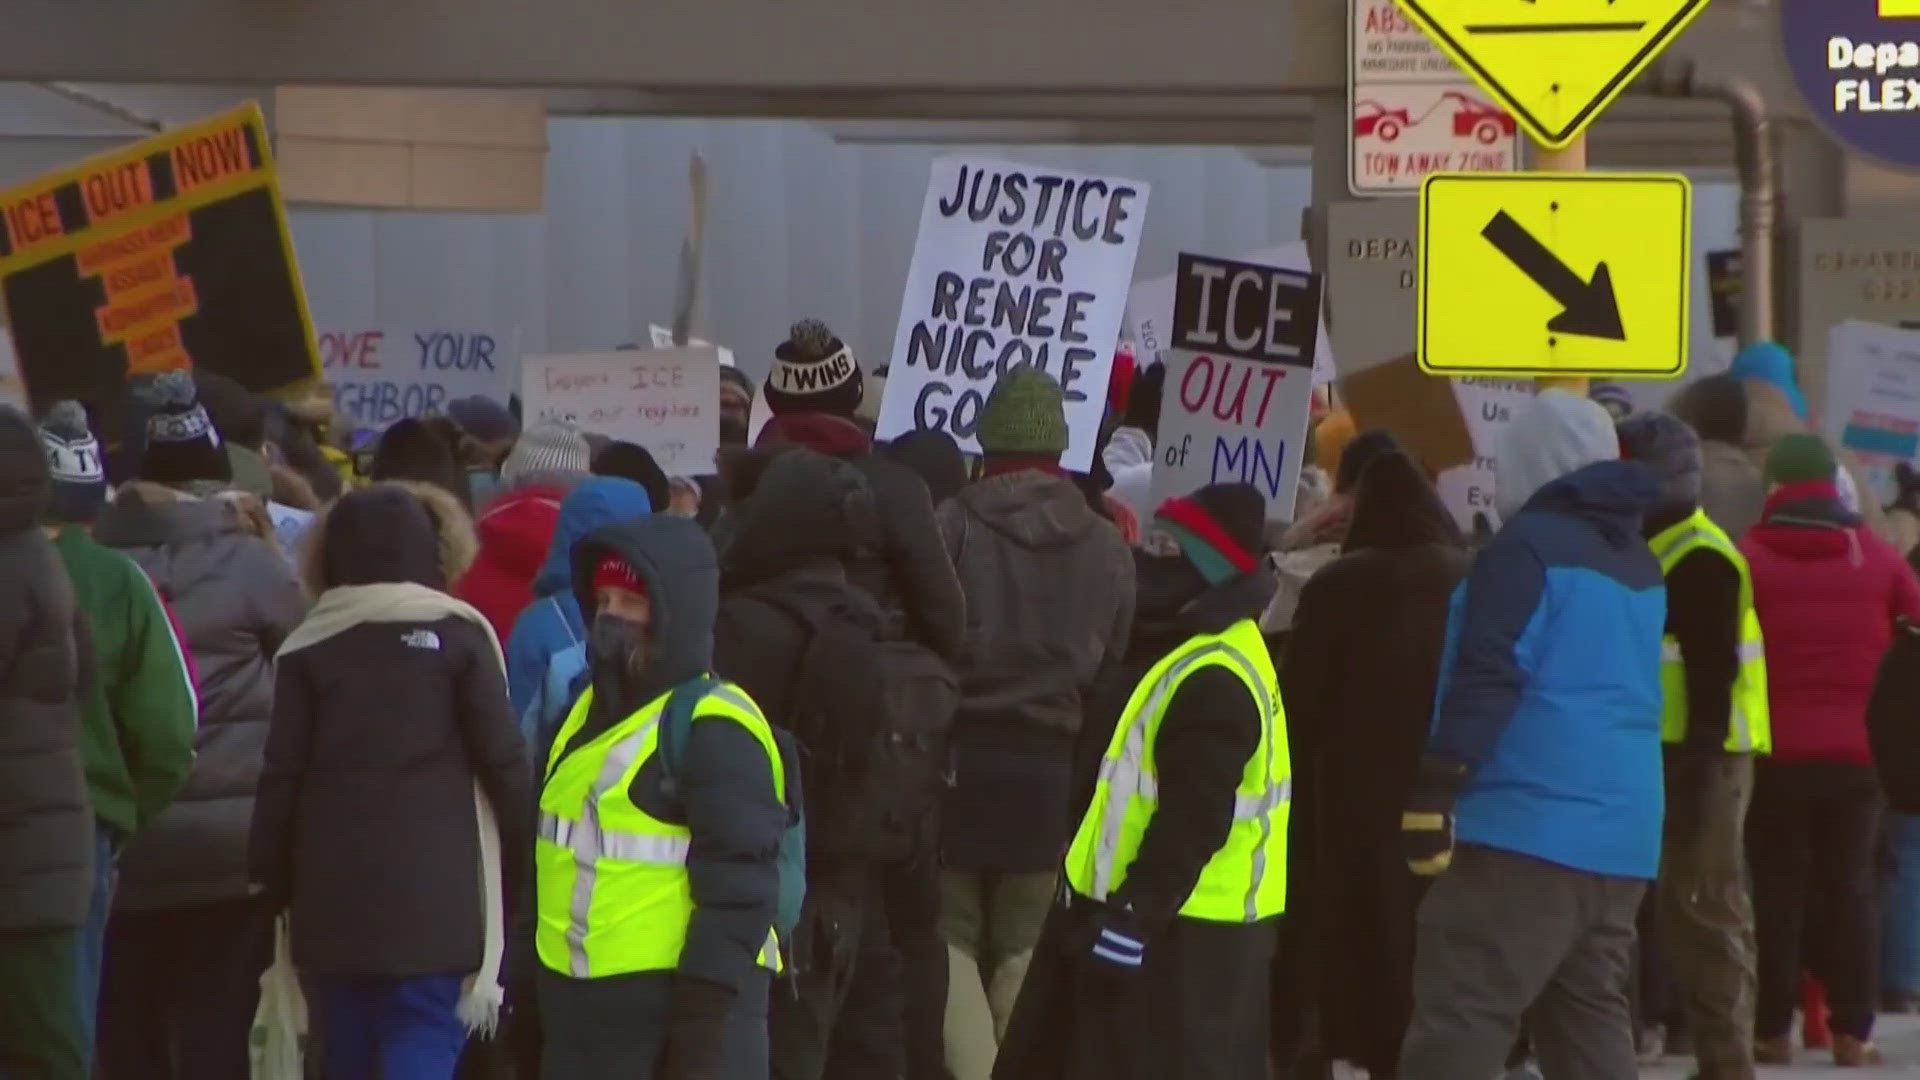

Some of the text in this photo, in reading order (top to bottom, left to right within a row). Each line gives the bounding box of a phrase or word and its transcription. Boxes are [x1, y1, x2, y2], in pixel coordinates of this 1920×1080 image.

[1365, 7, 1409, 33] ABS
[1828, 37, 1920, 75] Depa
[1364, 152, 1505, 175] TOW AWAY ZONE
[7, 192, 60, 246] ICE
[88, 163, 143, 217] OUT
[176, 127, 243, 190] NOW
[939, 165, 1136, 244] JUSTICE
[983, 231, 1067, 283] FOR
[1347, 239, 1414, 258] DEPA
[931, 271, 1096, 343] RENEE
[1185, 262, 1309, 358] ICE
[319, 331, 496, 372] OVE YOUR
[782, 353, 851, 390] TWINS
[631, 366, 684, 389] ICE
[1180, 356, 1286, 428] OUT
[336, 381, 446, 423] GHBOR
[914, 381, 984, 440] GO
[1482, 401, 1510, 422] Us
[1165, 434, 1285, 499] of MN
[1467, 487, 1493, 507] Ev
